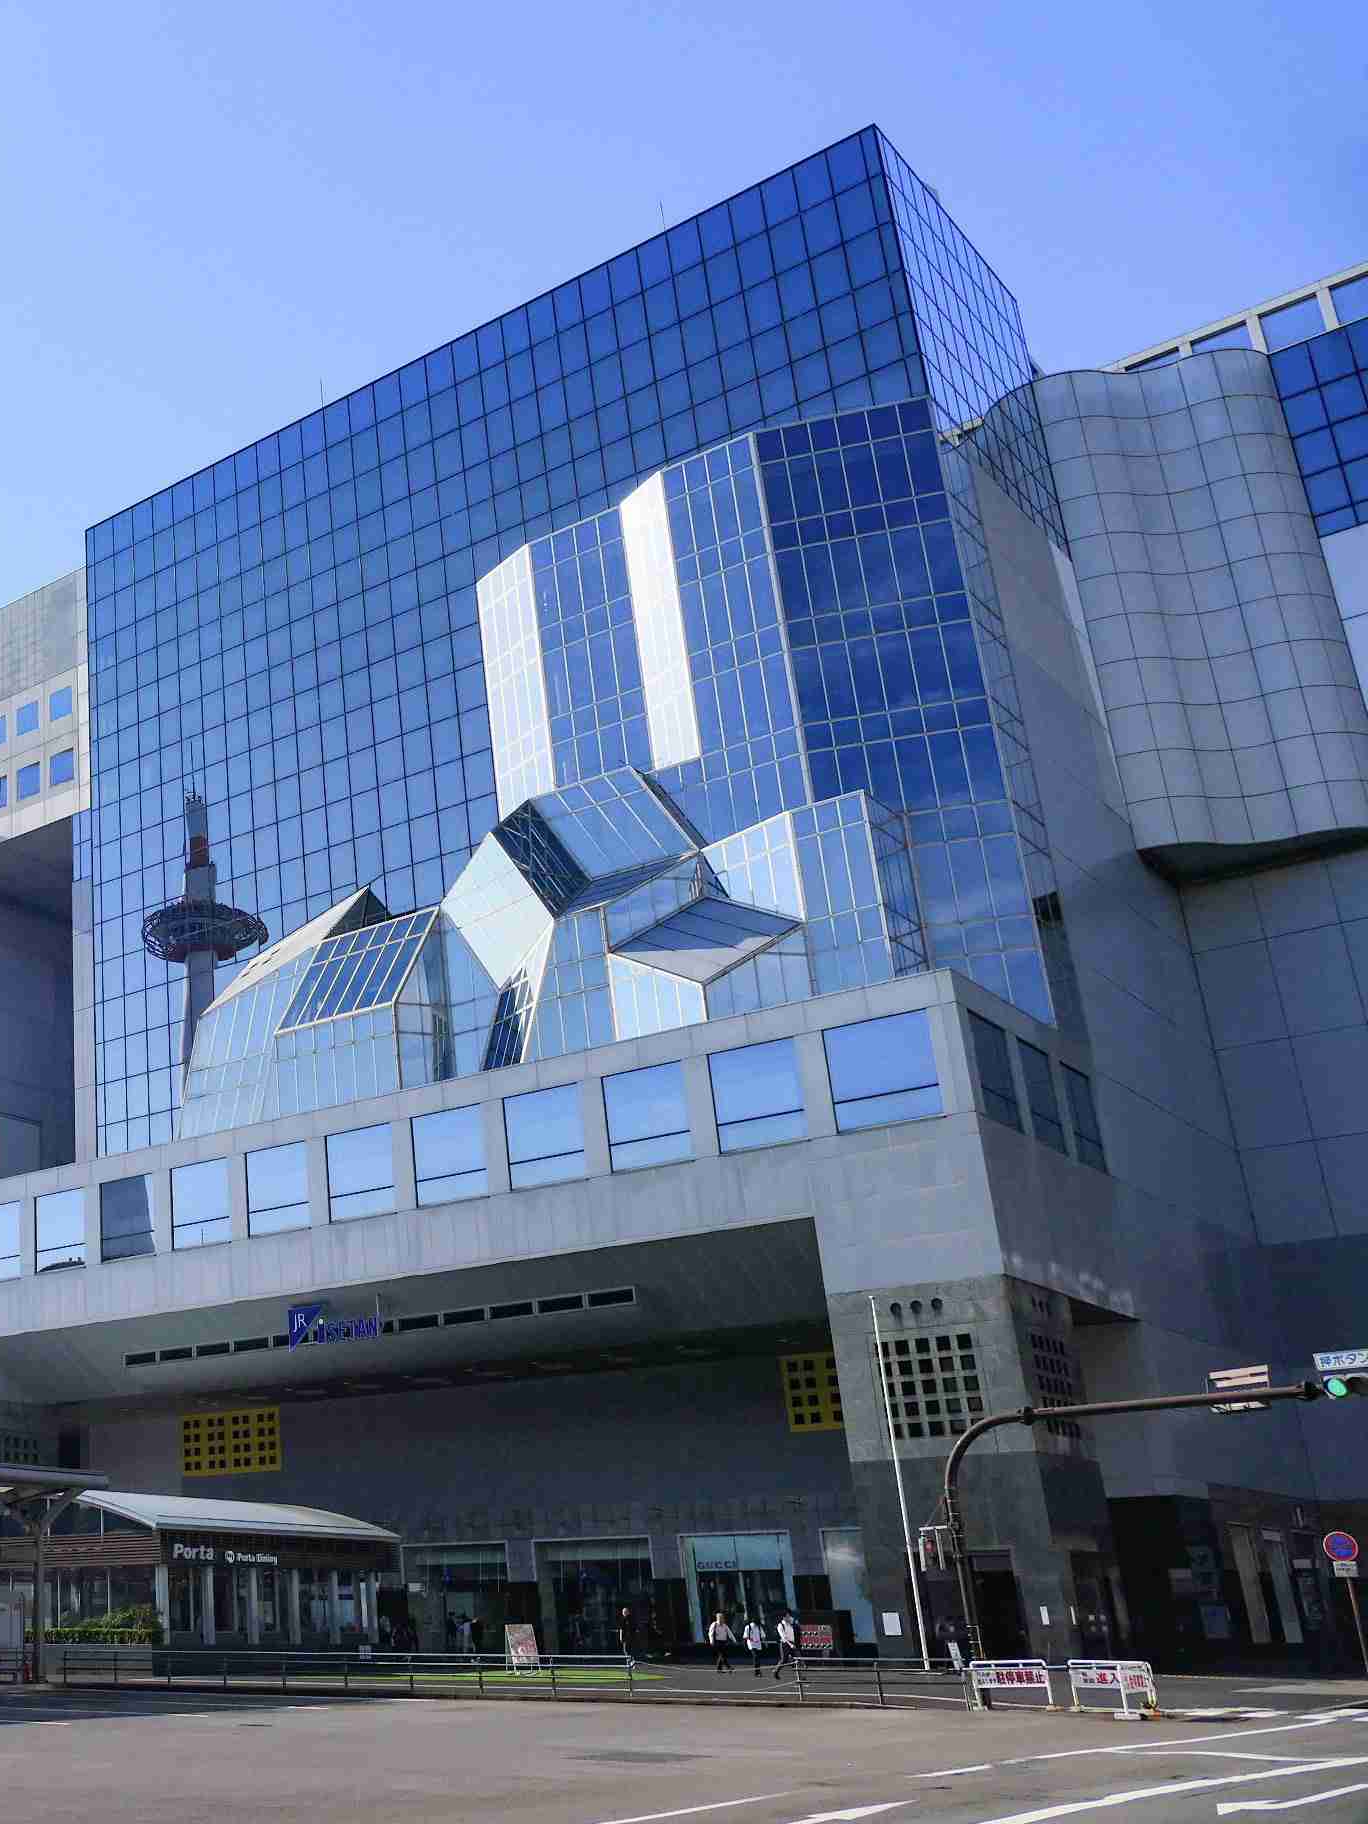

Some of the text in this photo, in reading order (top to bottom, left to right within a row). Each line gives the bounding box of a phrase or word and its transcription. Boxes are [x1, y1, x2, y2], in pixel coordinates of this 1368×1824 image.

[293, 1312, 308, 1333] JR
[173, 1543, 214, 1560] Porta
[696, 1560, 736, 1569] GUCCI
